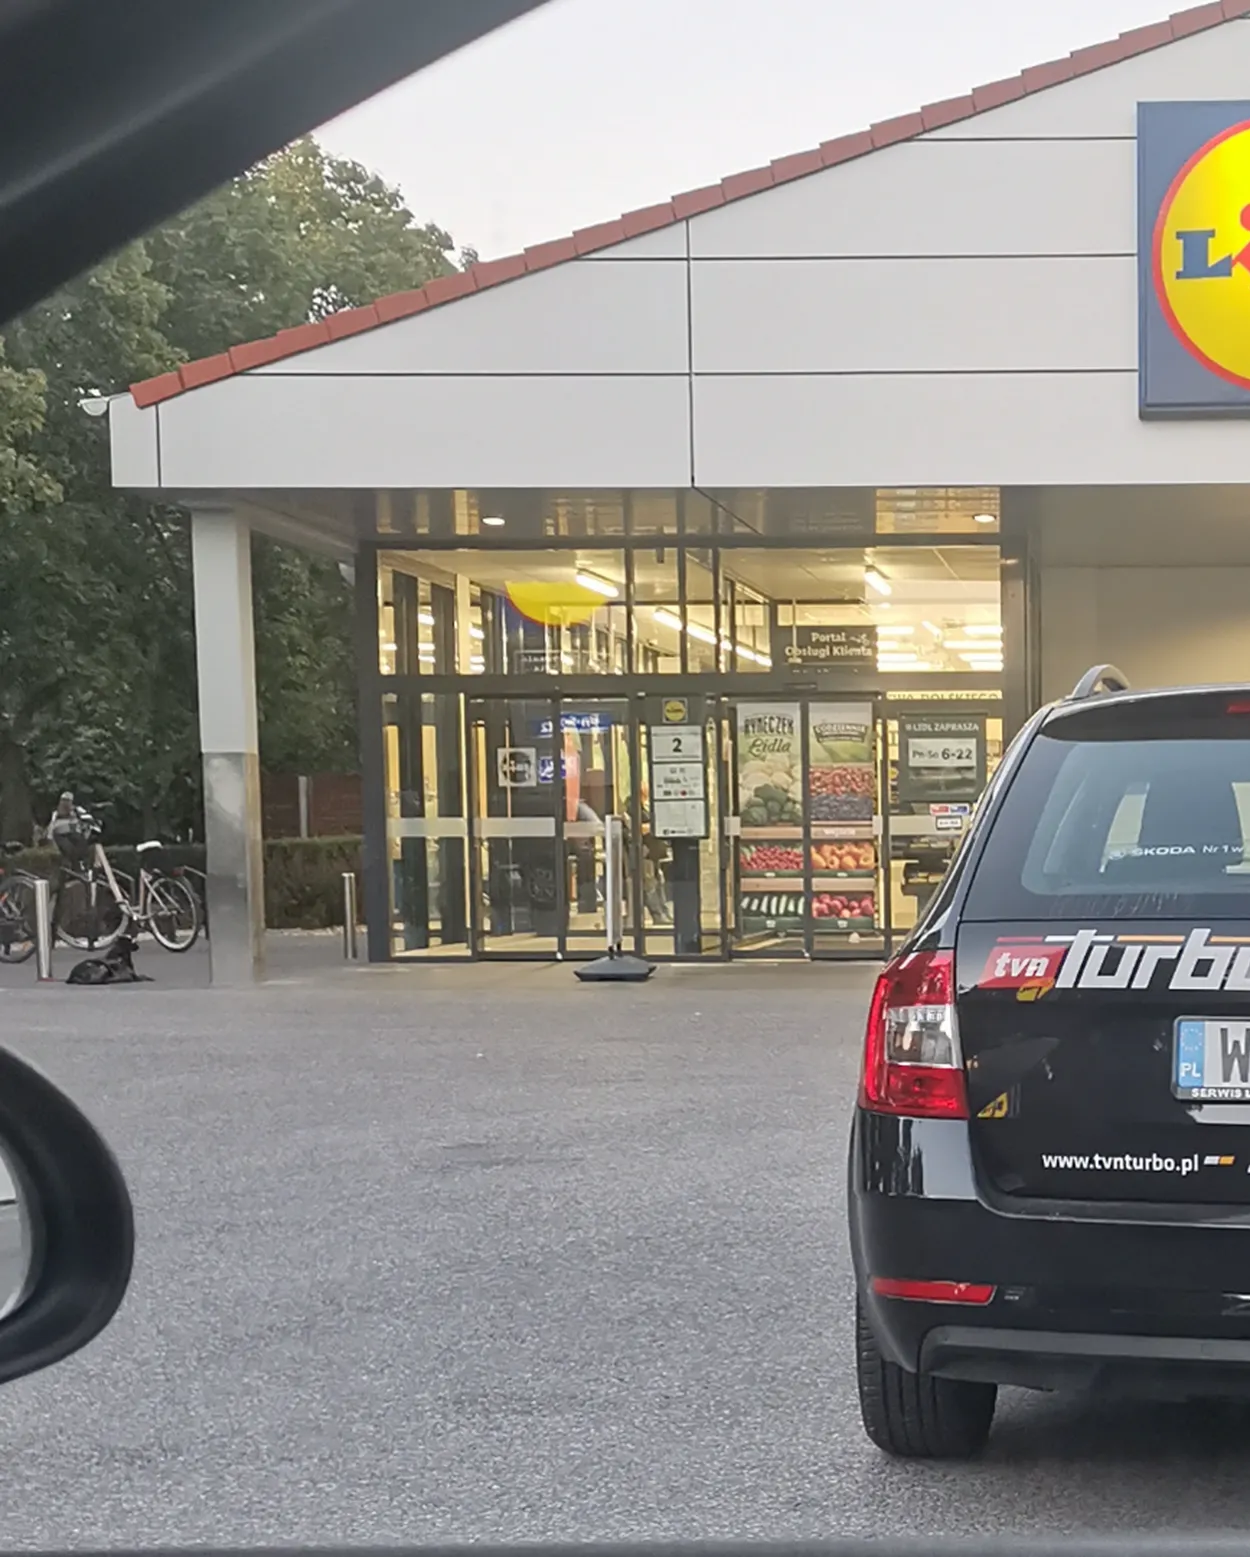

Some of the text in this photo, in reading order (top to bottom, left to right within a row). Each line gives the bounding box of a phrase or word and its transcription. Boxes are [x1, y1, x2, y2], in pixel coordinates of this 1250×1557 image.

[811, 632, 846, 643] Portal
[832, 646, 873, 657] Klienta
[934, 721, 980, 732] ZAPRASZA
[672, 737, 682, 753] 2
[941, 748, 973, 760] 6-22
[1202, 844, 1218, 853] Nr
[993, 951, 1050, 977] tvn
[1179, 1063, 1201, 1078] PL
[1042, 1152, 1199, 1176] www.tvnturbo.pl
